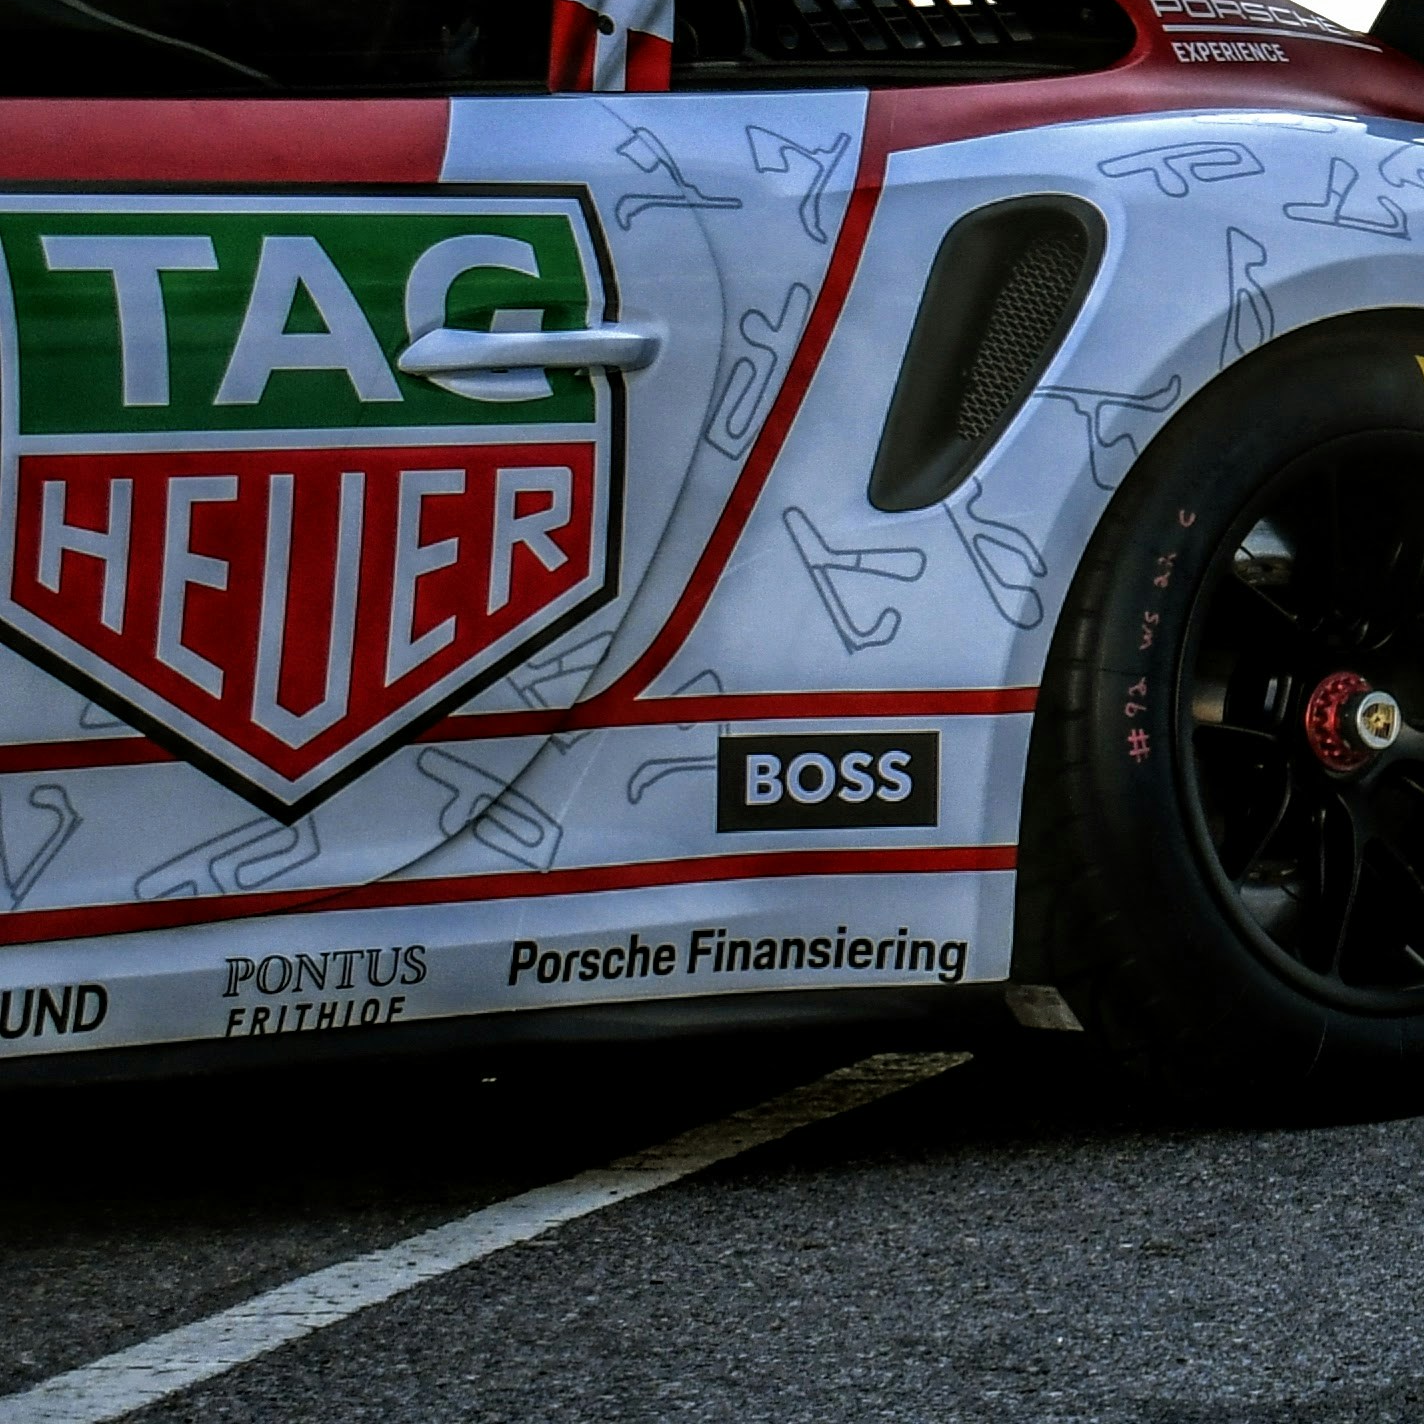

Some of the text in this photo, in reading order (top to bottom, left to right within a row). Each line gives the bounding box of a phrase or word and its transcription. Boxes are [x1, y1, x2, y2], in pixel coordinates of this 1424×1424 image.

[1171, 41, 1290, 63] EXPERIENCE
[40, 234, 555, 407] TAG
[37, 466, 573, 750] HEUER
[744, 750, 914, 806] BOSS
[223, 943, 428, 998] PONTUS
[508, 924, 968, 987] Porsche Finansiering
[225, 996, 407, 1038] FRITHIOF
